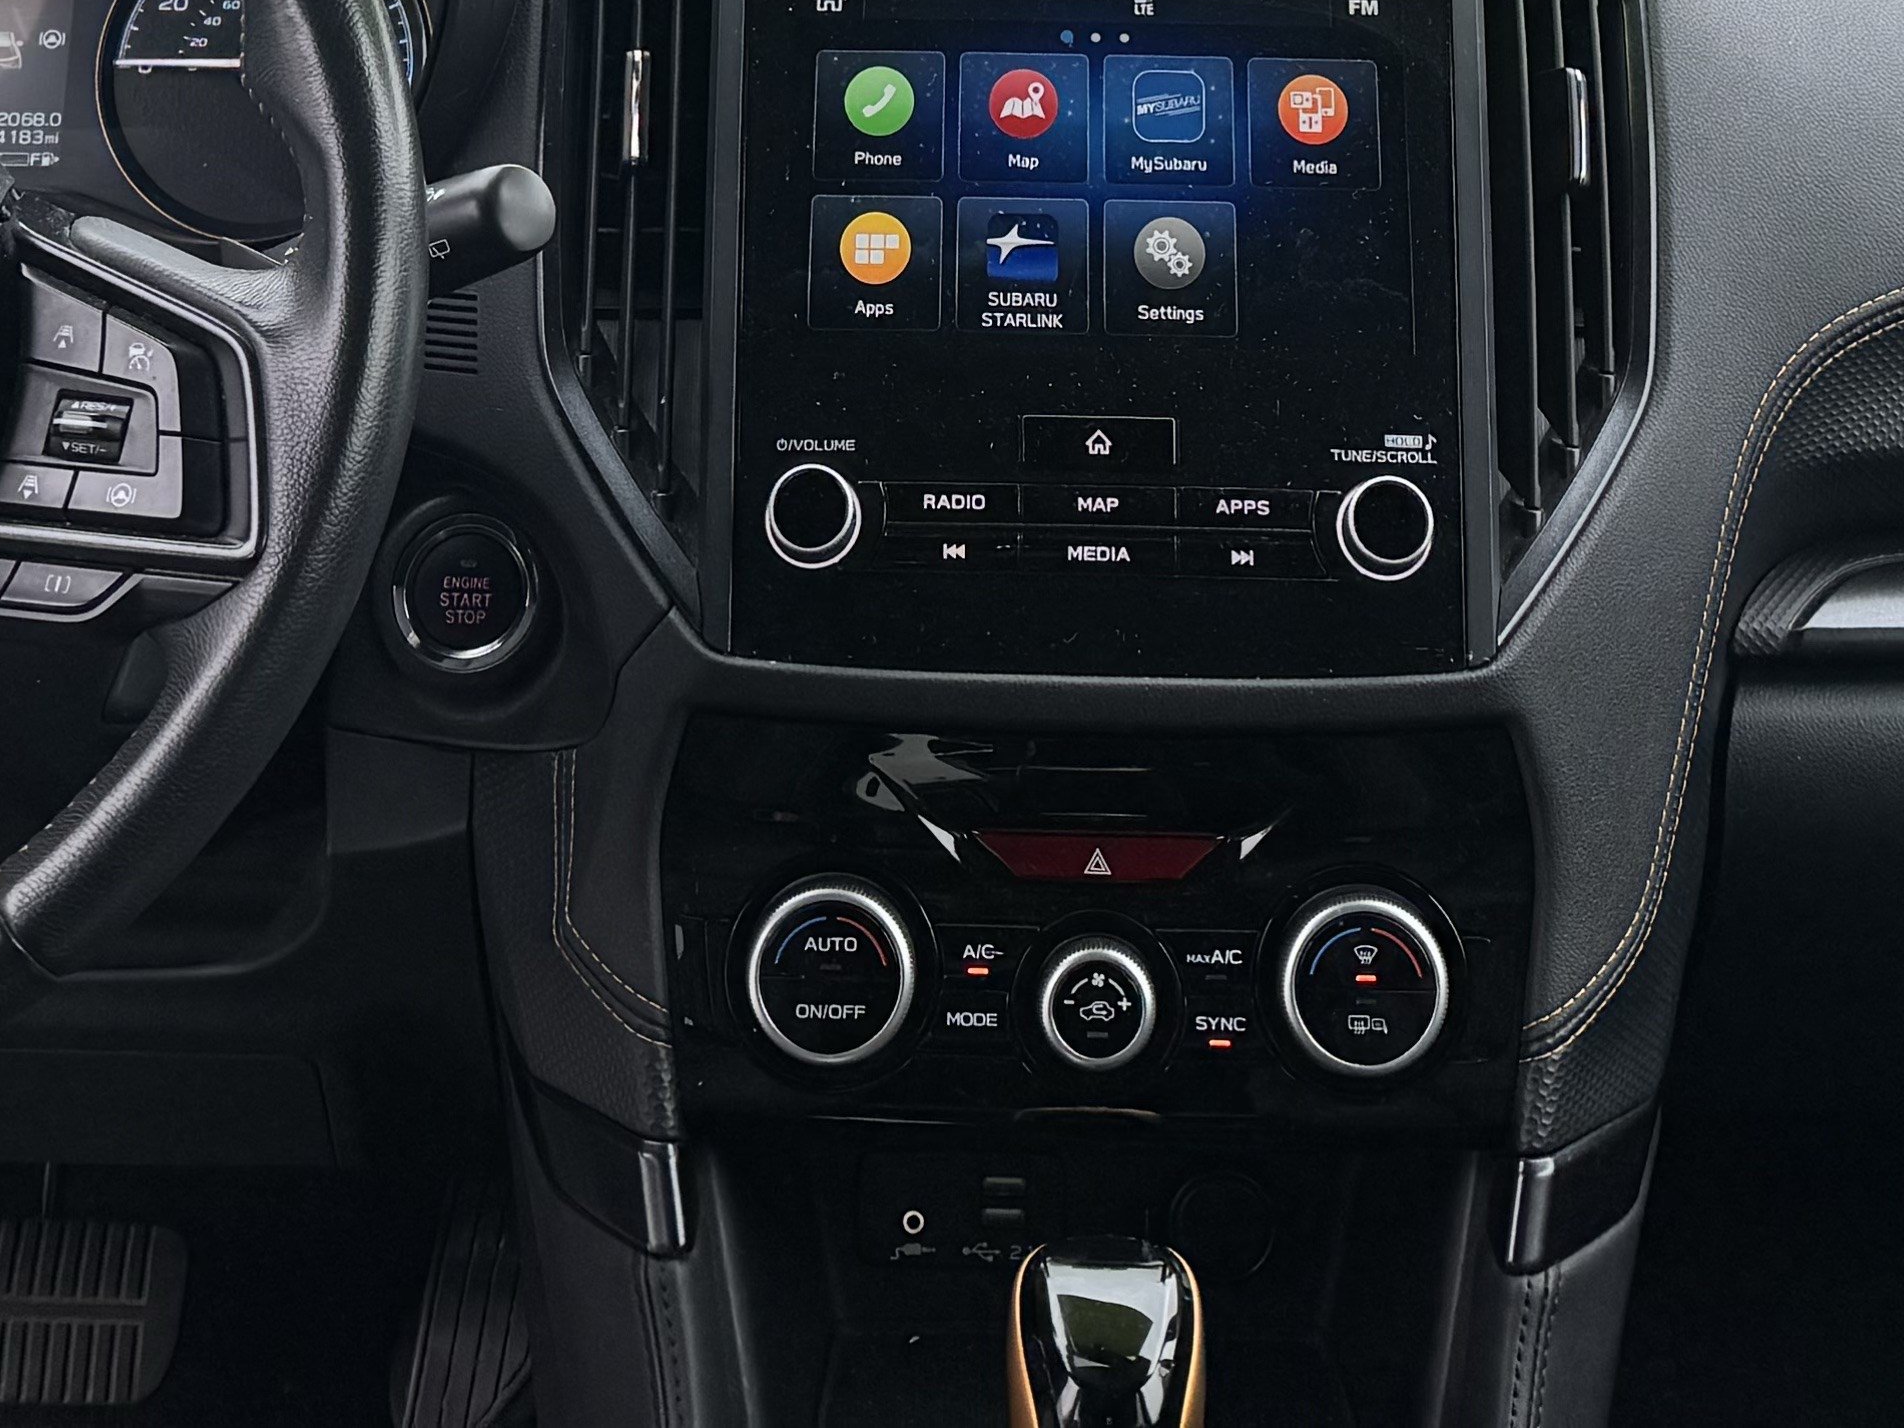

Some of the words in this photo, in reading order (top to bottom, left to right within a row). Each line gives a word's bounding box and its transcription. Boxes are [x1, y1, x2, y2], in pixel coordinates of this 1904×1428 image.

[222, 0, 241, 10] 60
[203, 16, 222, 26] 40
[189, 37, 208, 47] 20
[30, 152, 41, 166] F
[853, 150, 903, 168] Phone
[1007, 153, 1039, 172] Map
[1131, 156, 1207, 174] MySubaru
[1292, 158, 1338, 175] Media
[987, 291, 1058, 308] SUBARU
[854, 298, 895, 319] Apps
[1137, 304, 1205, 324] Settings
[981, 312, 1064, 329] STARLINK
[1330, 447, 1438, 464] TUNE/SCROLL
[922, 494, 986, 511] RADIO
[1077, 497, 1119, 513] MAP
[1215, 499, 1271, 516] APPS
[1067, 546, 1130, 563] MEDIA
[443, 575, 491, 591] ENGINE
[439, 591, 493, 609] START
[444, 609, 487, 626] STOP
[803, 936, 858, 953] AUTO
[1210, 949, 1243, 965] A/C
[794, 1003, 866, 1021] ON/OFF
[946, 1011, 998, 1028] MODE
[1194, 1015, 1246, 1032] SYNC
